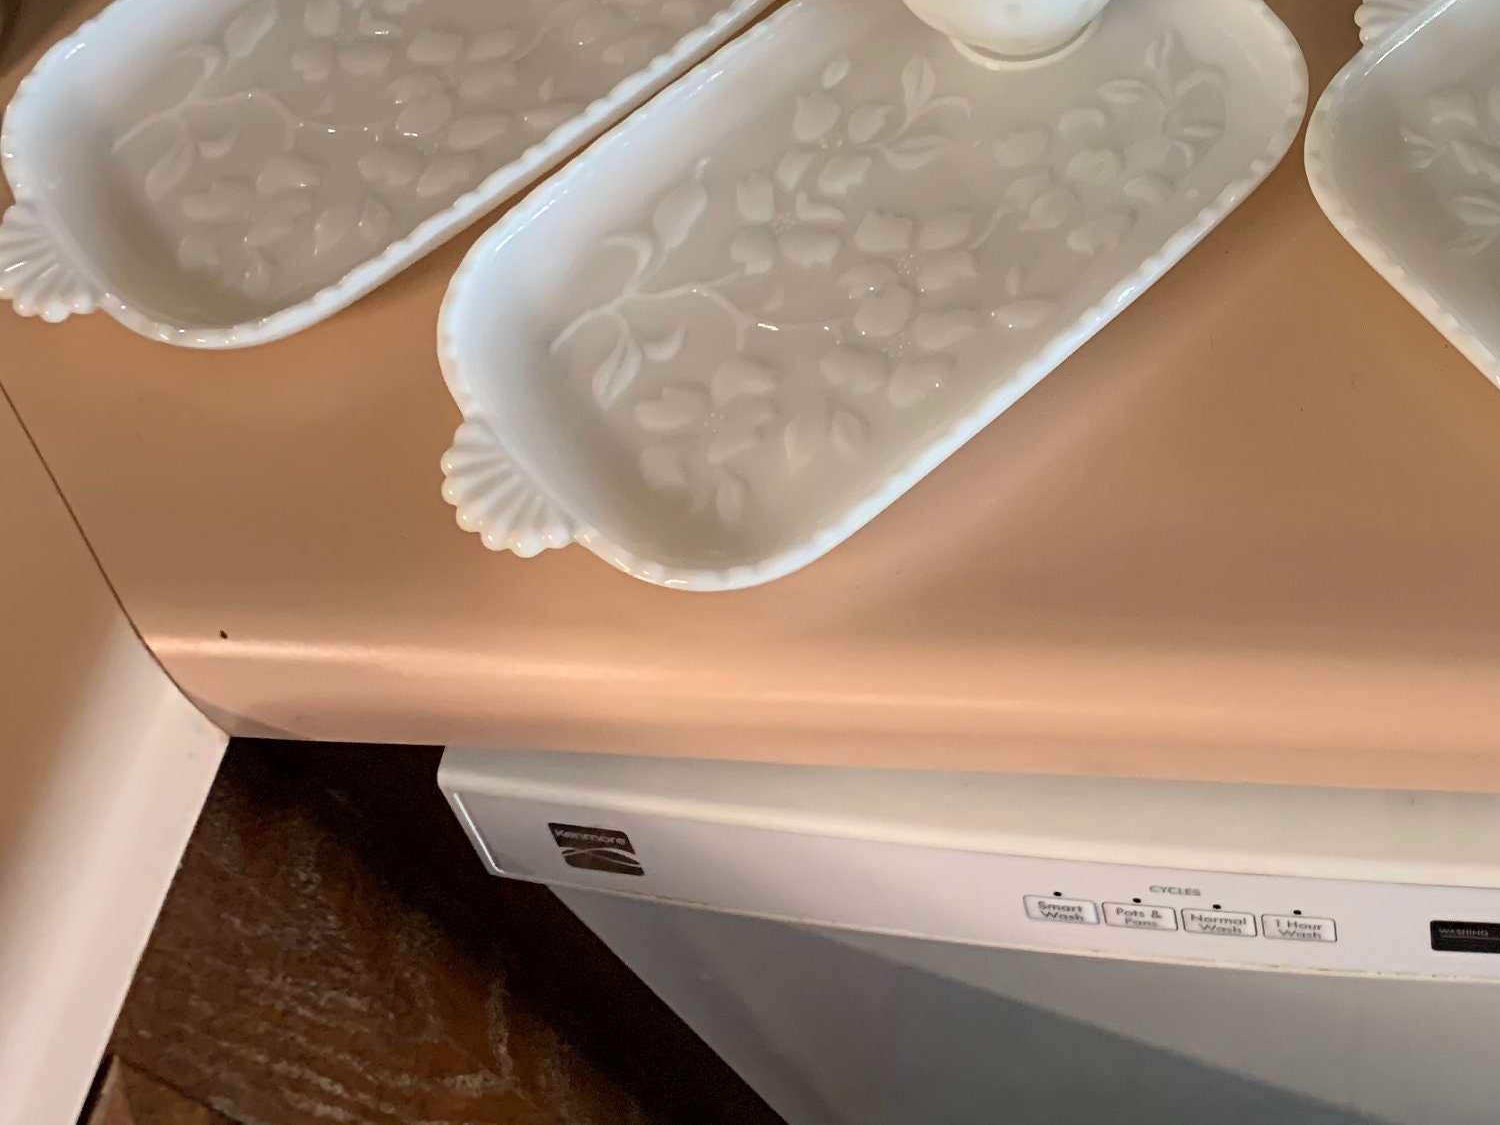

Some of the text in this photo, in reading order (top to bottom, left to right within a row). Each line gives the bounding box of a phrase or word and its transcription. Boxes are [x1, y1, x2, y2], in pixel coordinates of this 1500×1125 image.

[1149, 885, 1201, 897] CYCLES
[1038, 901, 1082, 913] Smart
[1041, 911, 1084, 922] Wash
[1116, 907, 1162, 919] Pots &
[1190, 913, 1247, 925] Normal
[1199, 924, 1242, 934] Wash
[1287, 921, 1323, 931] Hour
[1279, 930, 1322, 939] Wash
[1439, 928, 1489, 937] WASHING
